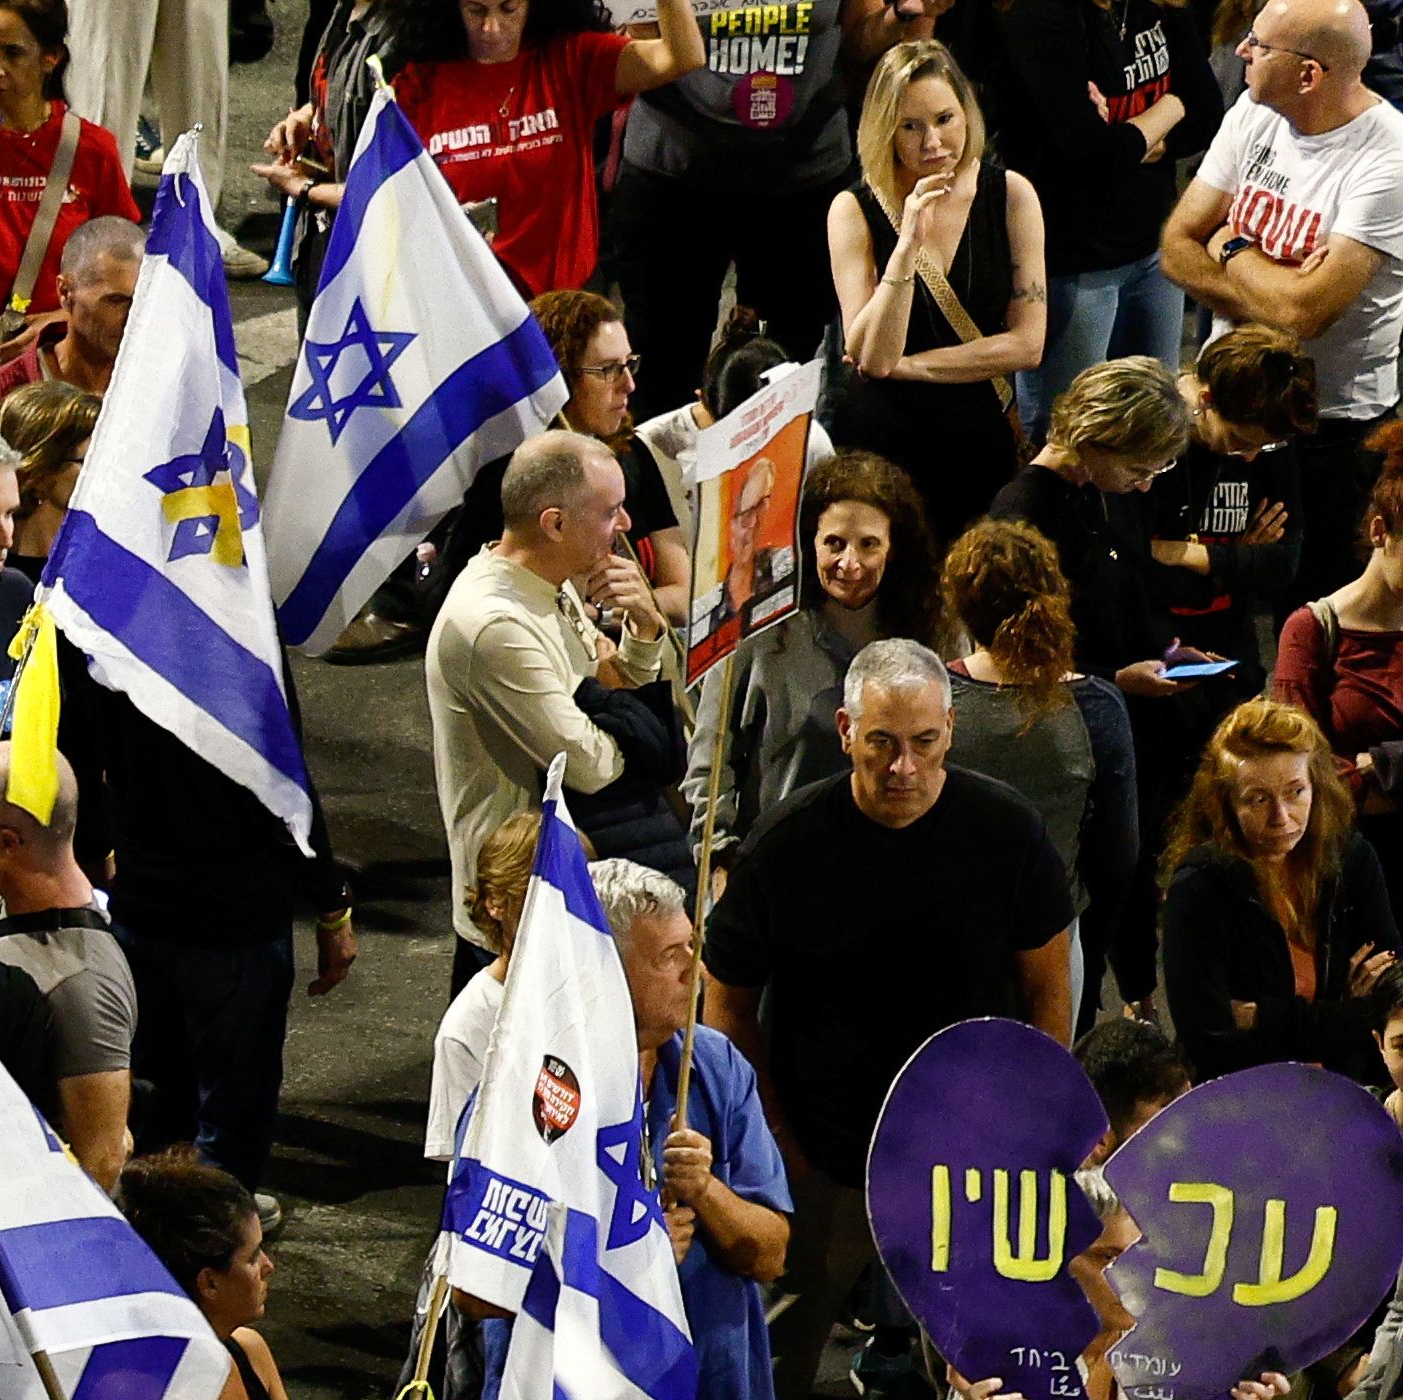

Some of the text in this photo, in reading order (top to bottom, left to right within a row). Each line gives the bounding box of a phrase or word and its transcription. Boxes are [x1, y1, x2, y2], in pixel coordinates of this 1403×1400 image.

[709, 2, 815, 36] PEOPLE
[709, 34, 810, 77] HOME!
[429, 123, 492, 156] הנשים
[1153, 1183, 1337, 1307] עכ
[1010, 1347, 1071, 1373] ביחד
[1109, 1351, 1183, 1377] עומדים
